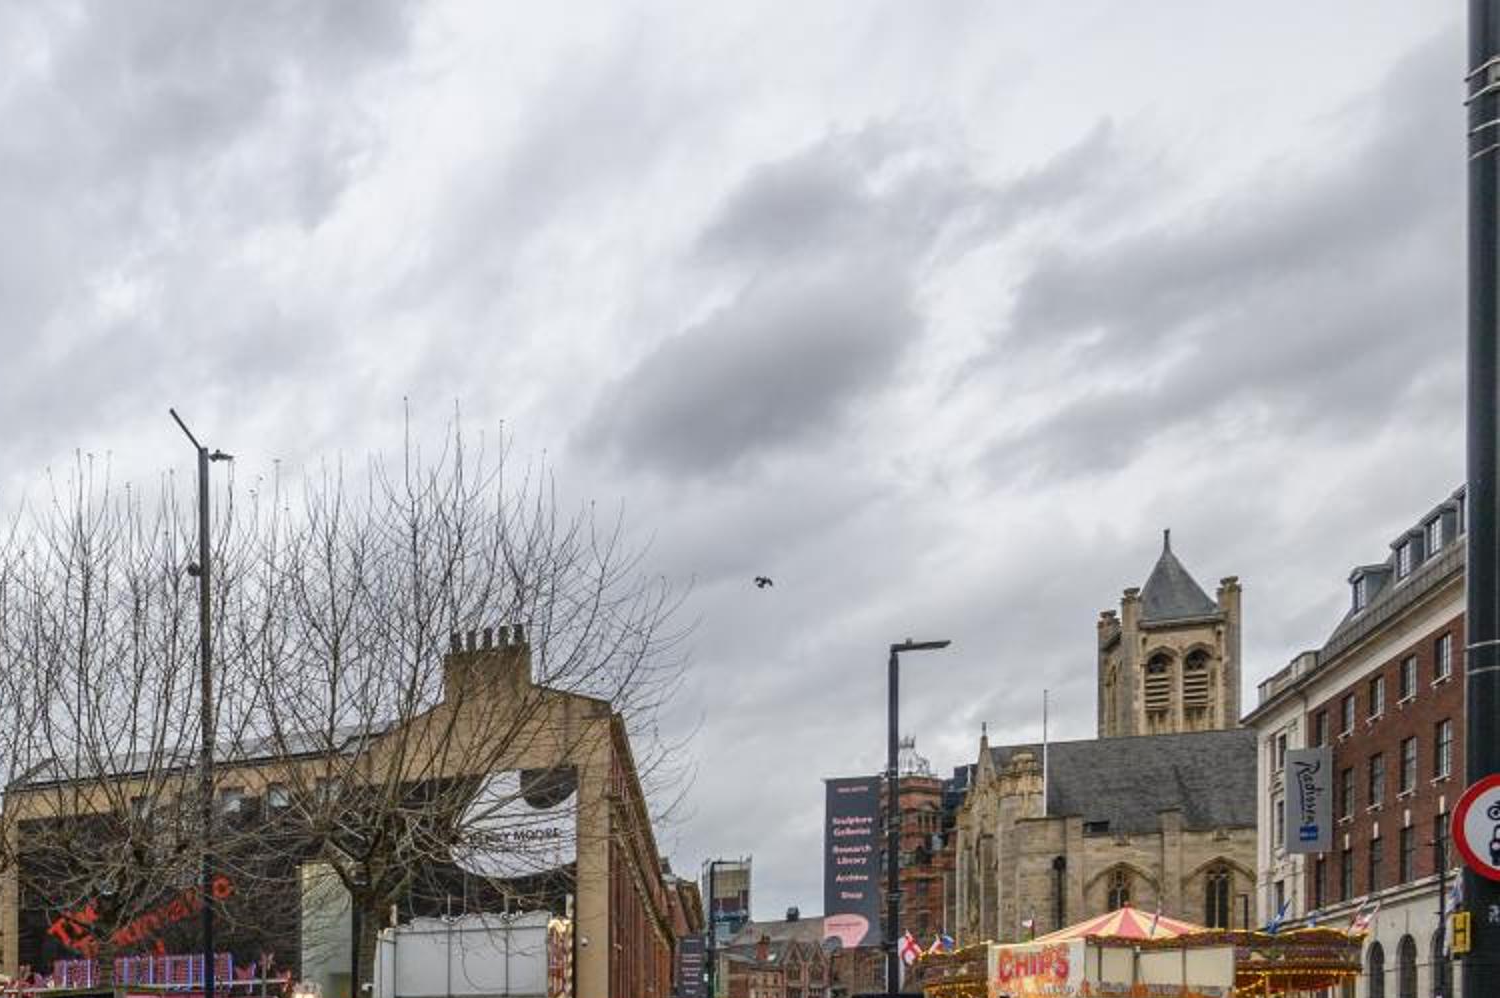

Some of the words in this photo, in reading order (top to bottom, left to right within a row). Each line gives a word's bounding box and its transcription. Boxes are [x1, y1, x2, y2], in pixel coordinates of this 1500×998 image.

[1292, 760, 1324, 824] Radisson
[837, 857, 868, 867] Library
[999, 945, 1070, 983] CHIPS
